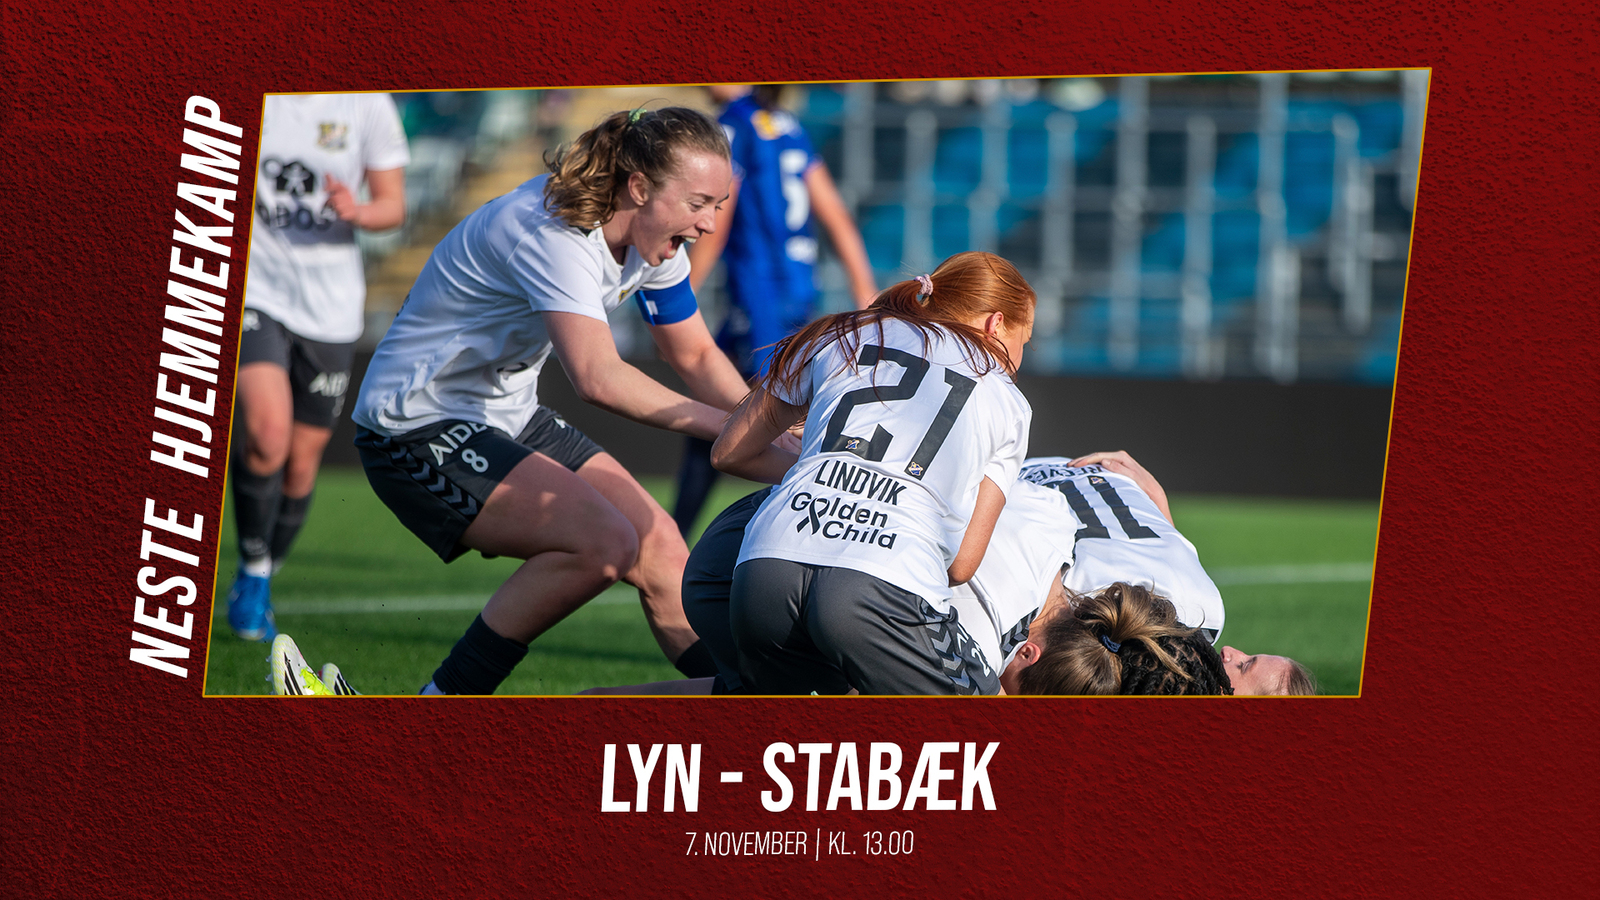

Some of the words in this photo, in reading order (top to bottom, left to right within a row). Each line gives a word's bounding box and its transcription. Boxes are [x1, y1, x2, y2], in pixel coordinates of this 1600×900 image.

[820, 344, 978, 481] 21
[461, 448, 489, 473] 8
[814, 460, 908, 506] LINDVIK
[790, 491, 888, 533] Golden
[822, 520, 898, 550] Child
